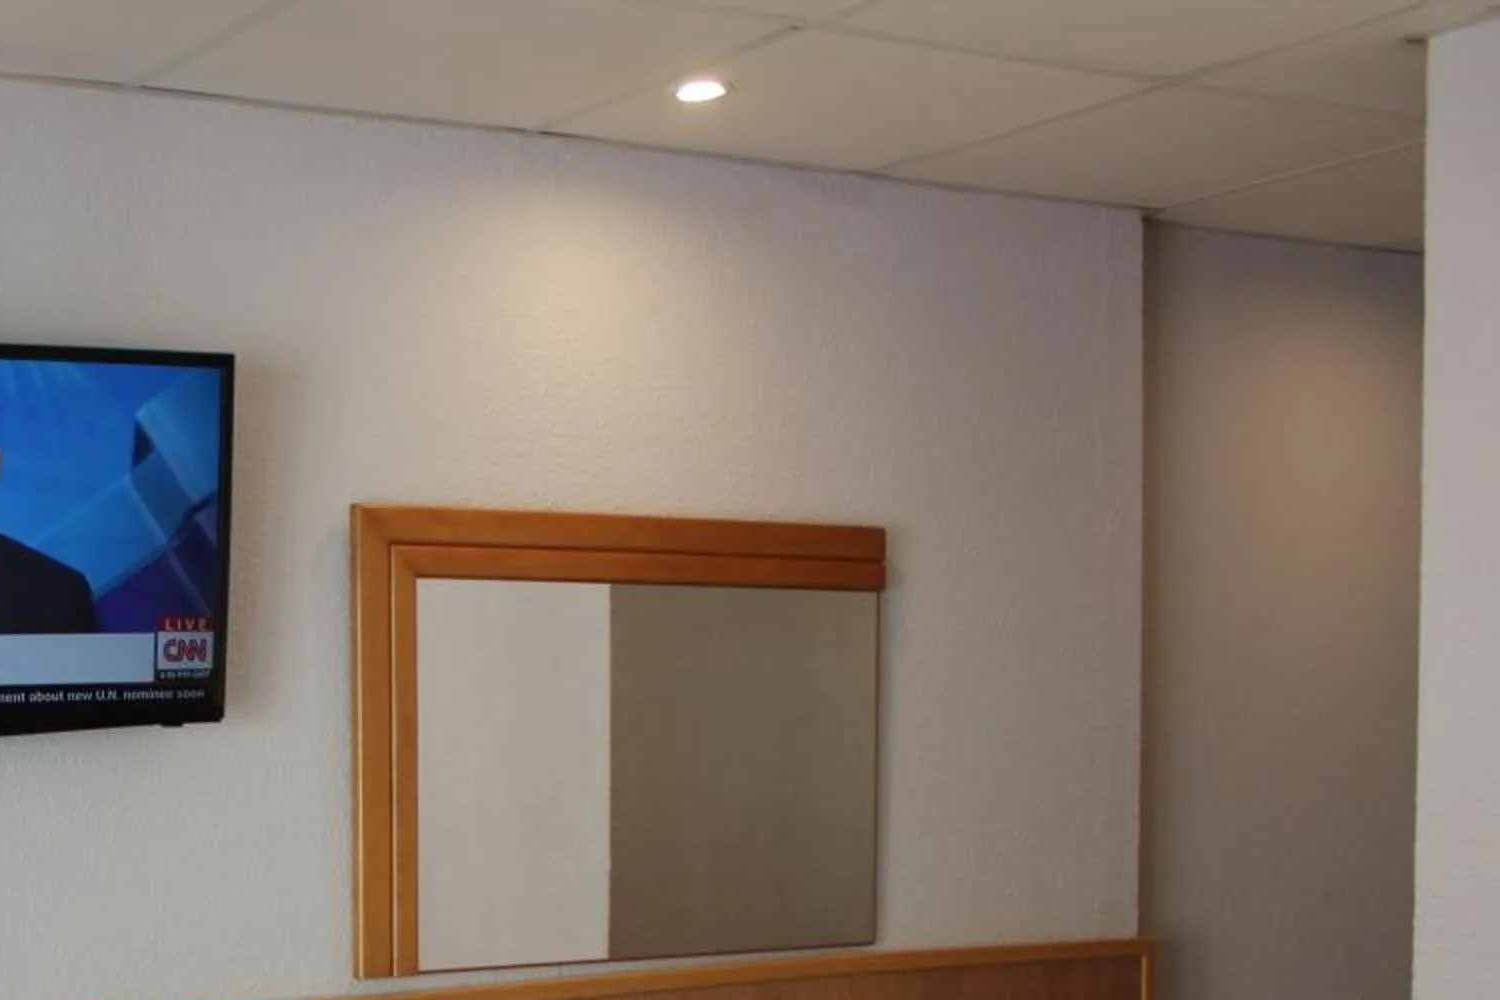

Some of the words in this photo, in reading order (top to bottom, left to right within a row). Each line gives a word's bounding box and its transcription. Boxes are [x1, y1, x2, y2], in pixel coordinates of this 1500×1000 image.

[164, 618, 207, 630] LIVE
[163, 638, 207, 663] CNN
[29, 689, 64, 703] about
[66, 691, 93, 702] new
[95, 688, 118, 701] U.N.
[123, 686, 174, 700] nominee
